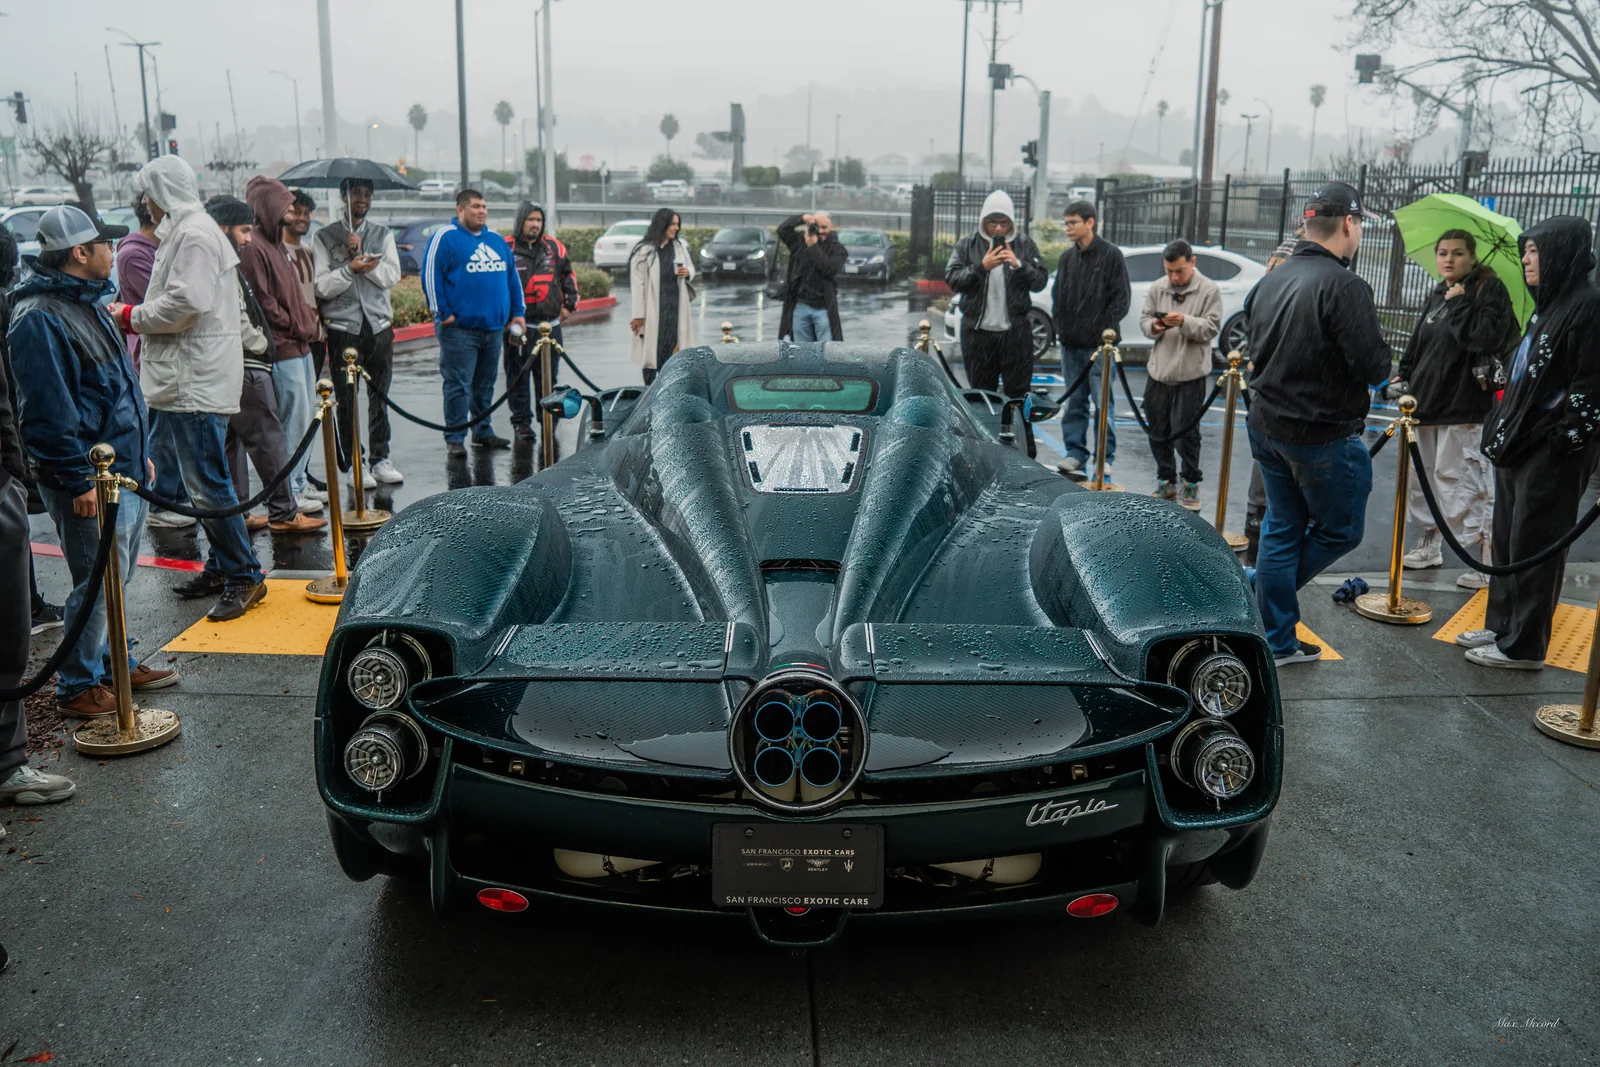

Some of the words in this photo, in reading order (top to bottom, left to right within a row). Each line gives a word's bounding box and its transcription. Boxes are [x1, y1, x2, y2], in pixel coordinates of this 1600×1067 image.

[466, 260, 507, 273] adidas
[1025, 798, 1119, 827] Utopia
[726, 896, 745, 904] SAN
[747, 896, 802, 905] FRANCISCO
[803, 897, 840, 905] EXOTIC
